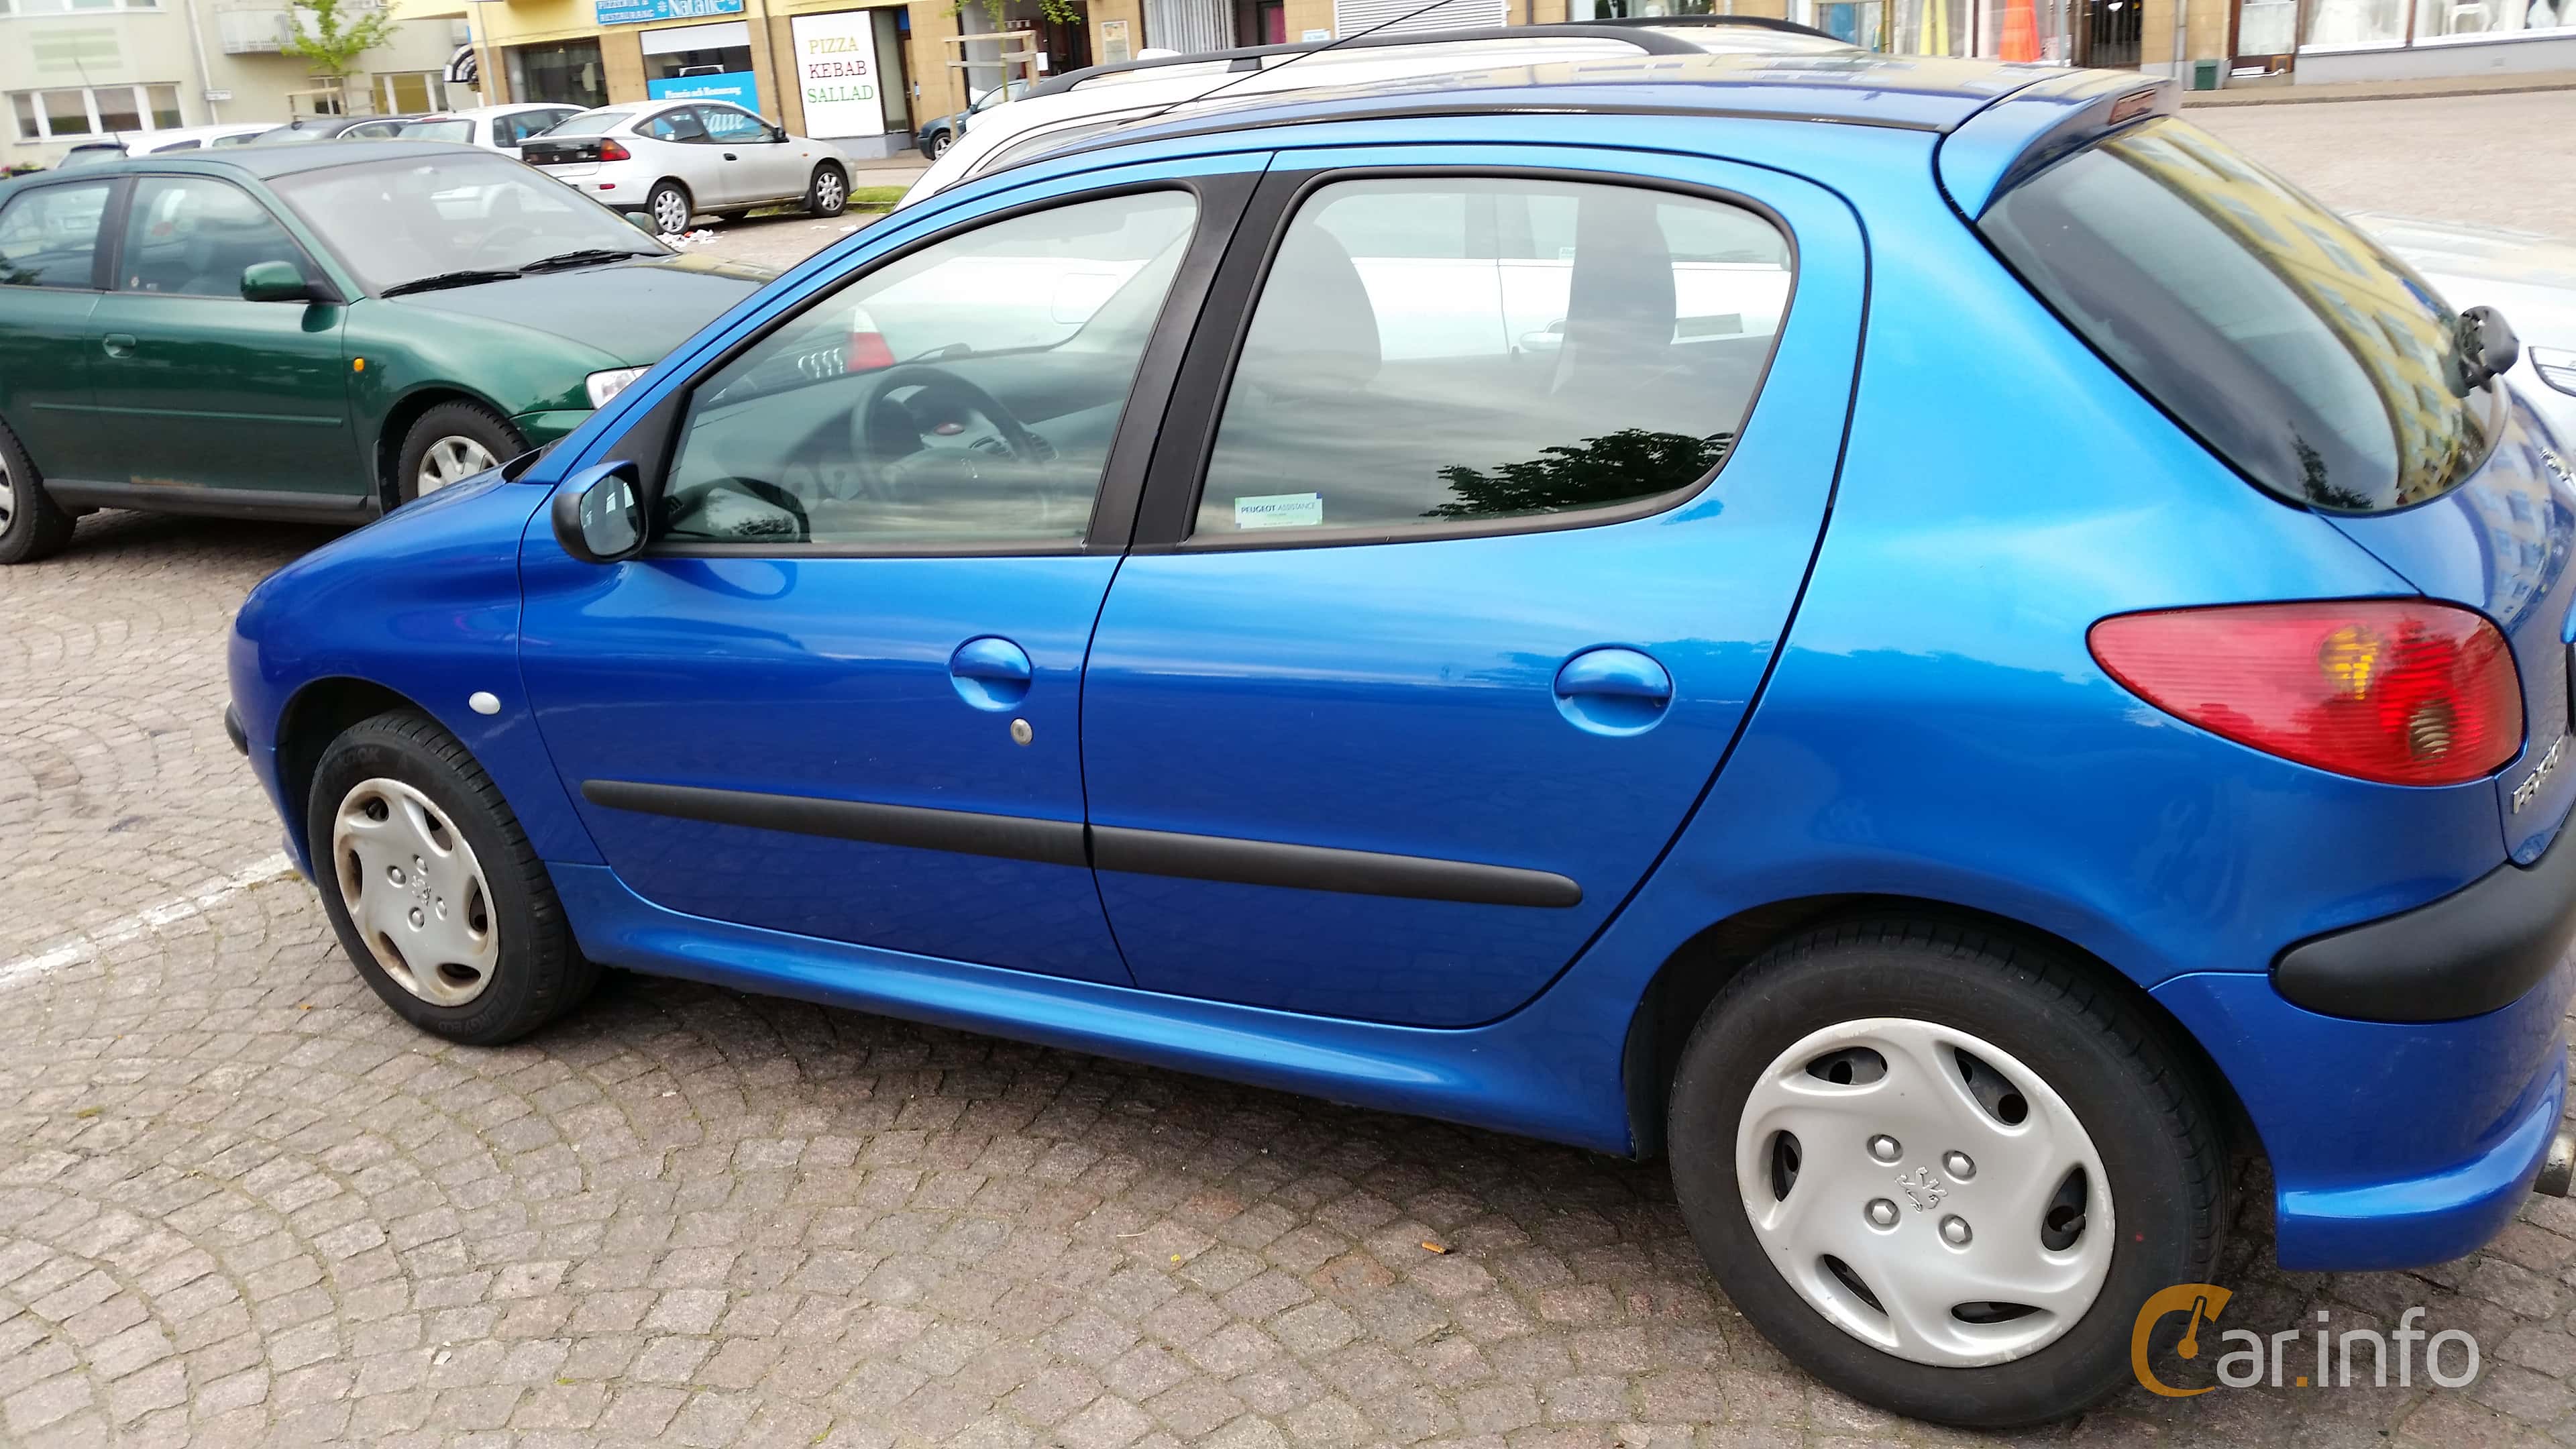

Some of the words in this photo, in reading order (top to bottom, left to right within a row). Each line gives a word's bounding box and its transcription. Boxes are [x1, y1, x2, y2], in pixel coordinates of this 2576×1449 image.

[808, 37, 859, 54] PIZZA
[808, 60, 867, 78] KEBAB
[807, 85, 873, 103] SALLAD
[1241, 504, 1275, 514] PEUGEOT
